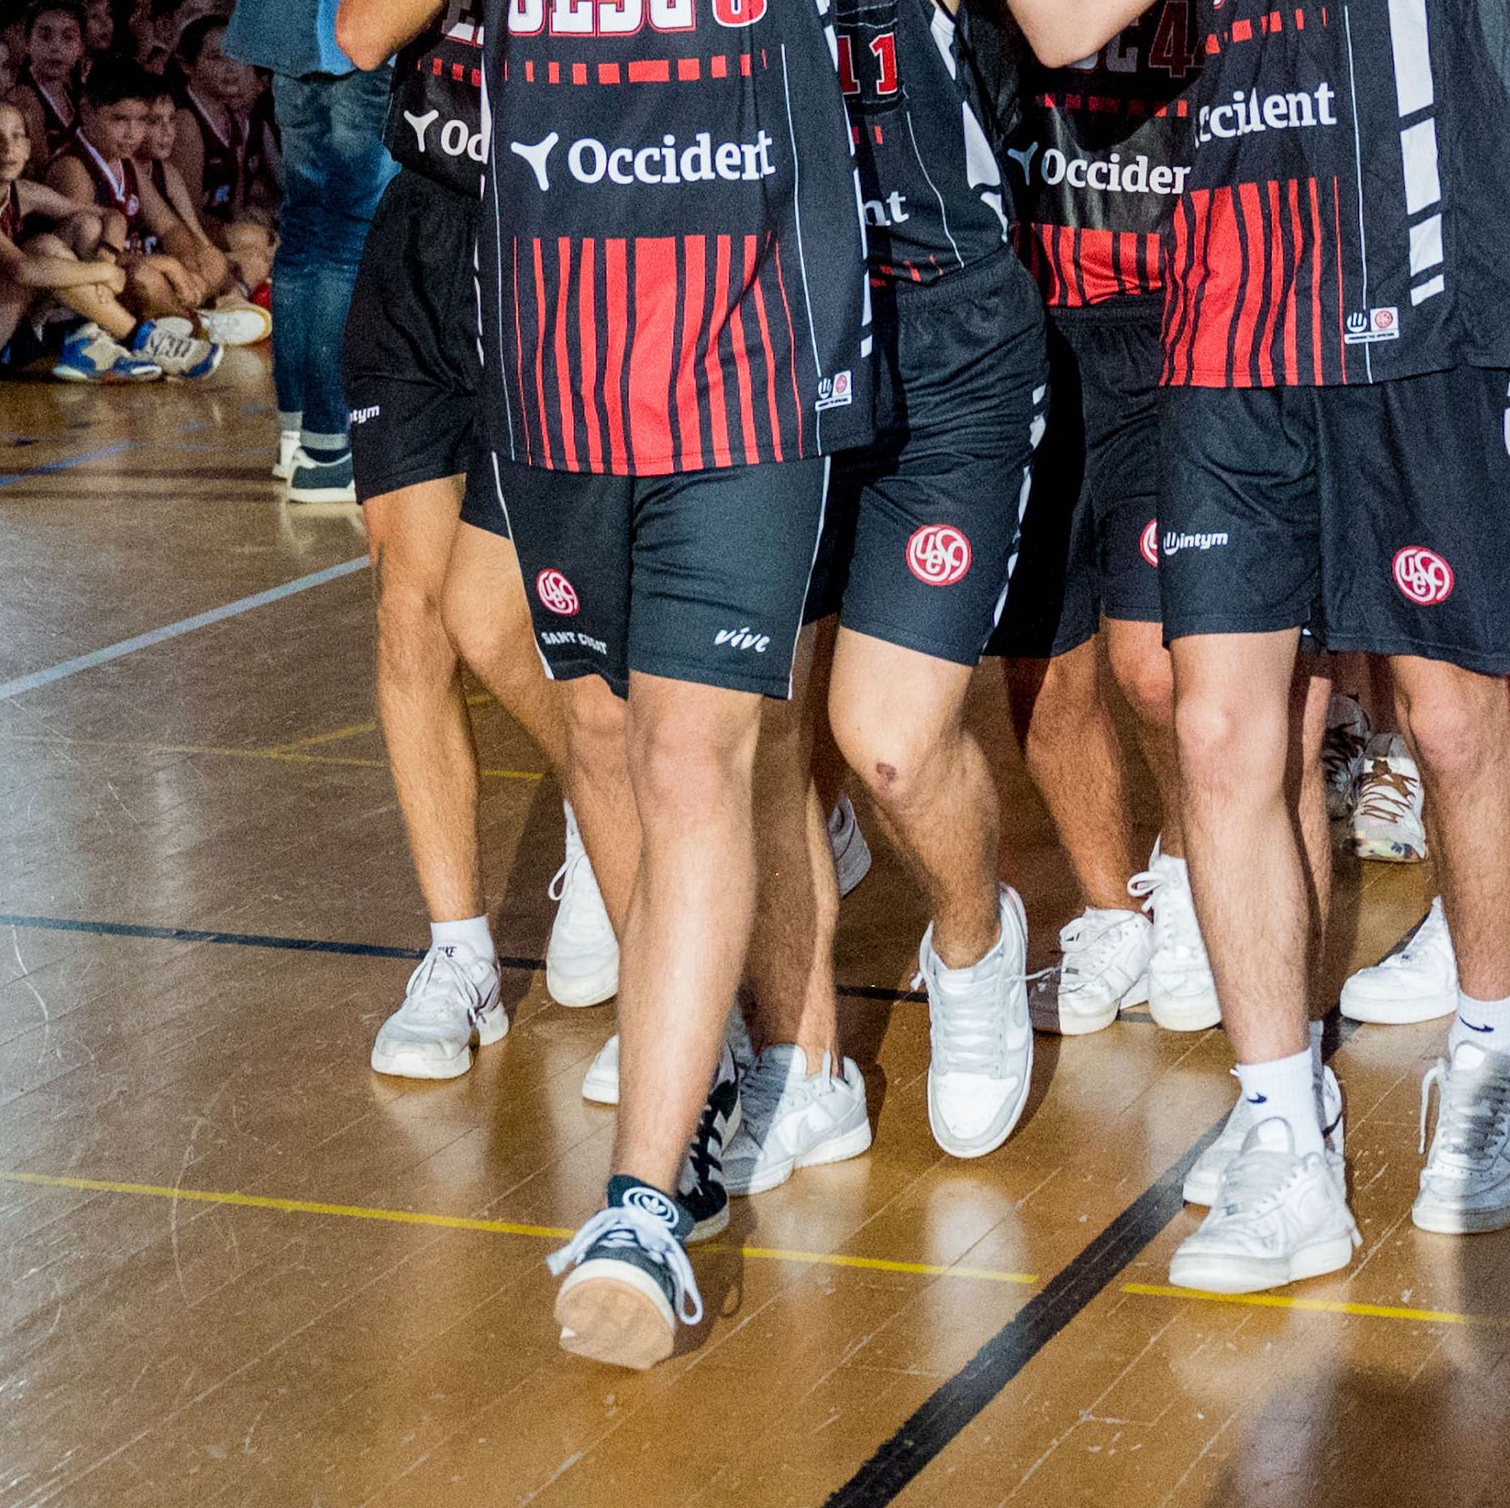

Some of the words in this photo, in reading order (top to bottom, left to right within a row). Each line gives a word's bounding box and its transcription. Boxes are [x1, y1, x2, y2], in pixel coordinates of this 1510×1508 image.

[1149, 0, 1203, 78] 4
[838, 32, 897, 95] 11
[568, 129, 775, 185] Occident
[1179, 530, 1228, 550] intym
[541, 631, 577, 646] SANT
[714, 627, 770, 653] vive
